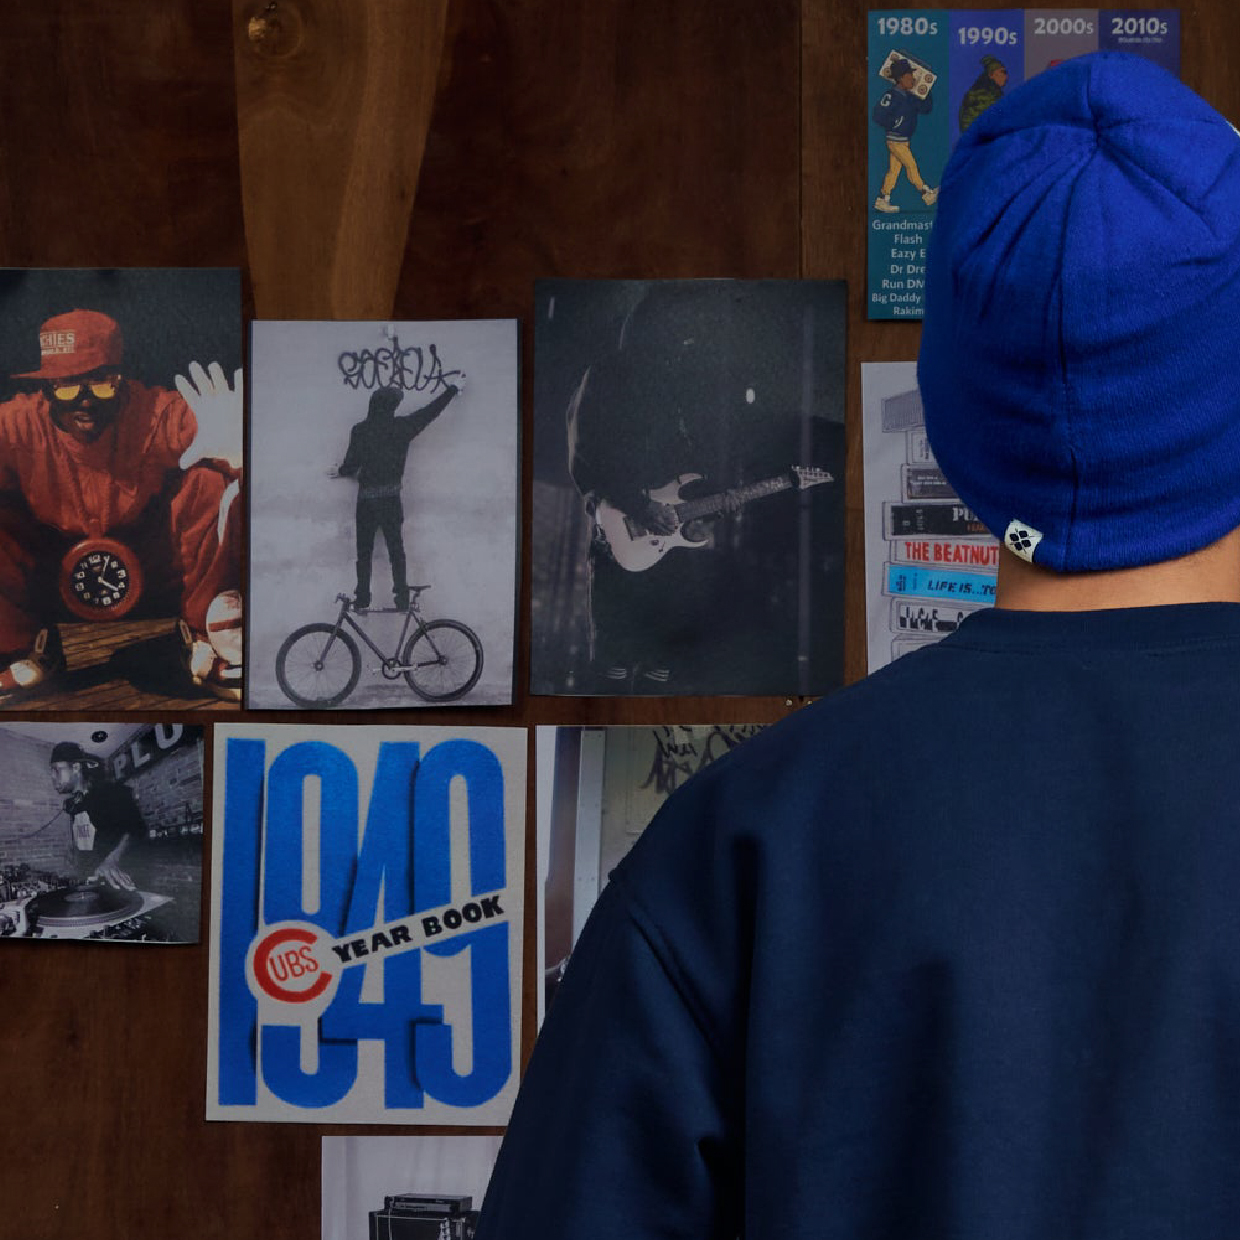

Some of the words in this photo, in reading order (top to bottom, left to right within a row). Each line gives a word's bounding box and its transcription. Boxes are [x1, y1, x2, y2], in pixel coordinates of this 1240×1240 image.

[877, 17, 938, 35] 1980s
[1034, 17, 1094, 35] 2000s
[1111, 17, 1168, 35] 2010s
[958, 27, 1017, 45] 1990s
[894, 233, 923, 245] Flash
[891, 248, 917, 261] Eazy
[920, 248, 927, 258] E
[890, 264, 903, 274] Dr
[882, 279, 904, 289] Run
[872, 293, 888, 305] Big
[890, 292, 921, 304] Daddy
[905, 541, 930, 562] THE
[928, 580, 958, 593] LIFE
[332, 924, 413, 964] YEAR
[422, 895, 505, 938] BOOK
